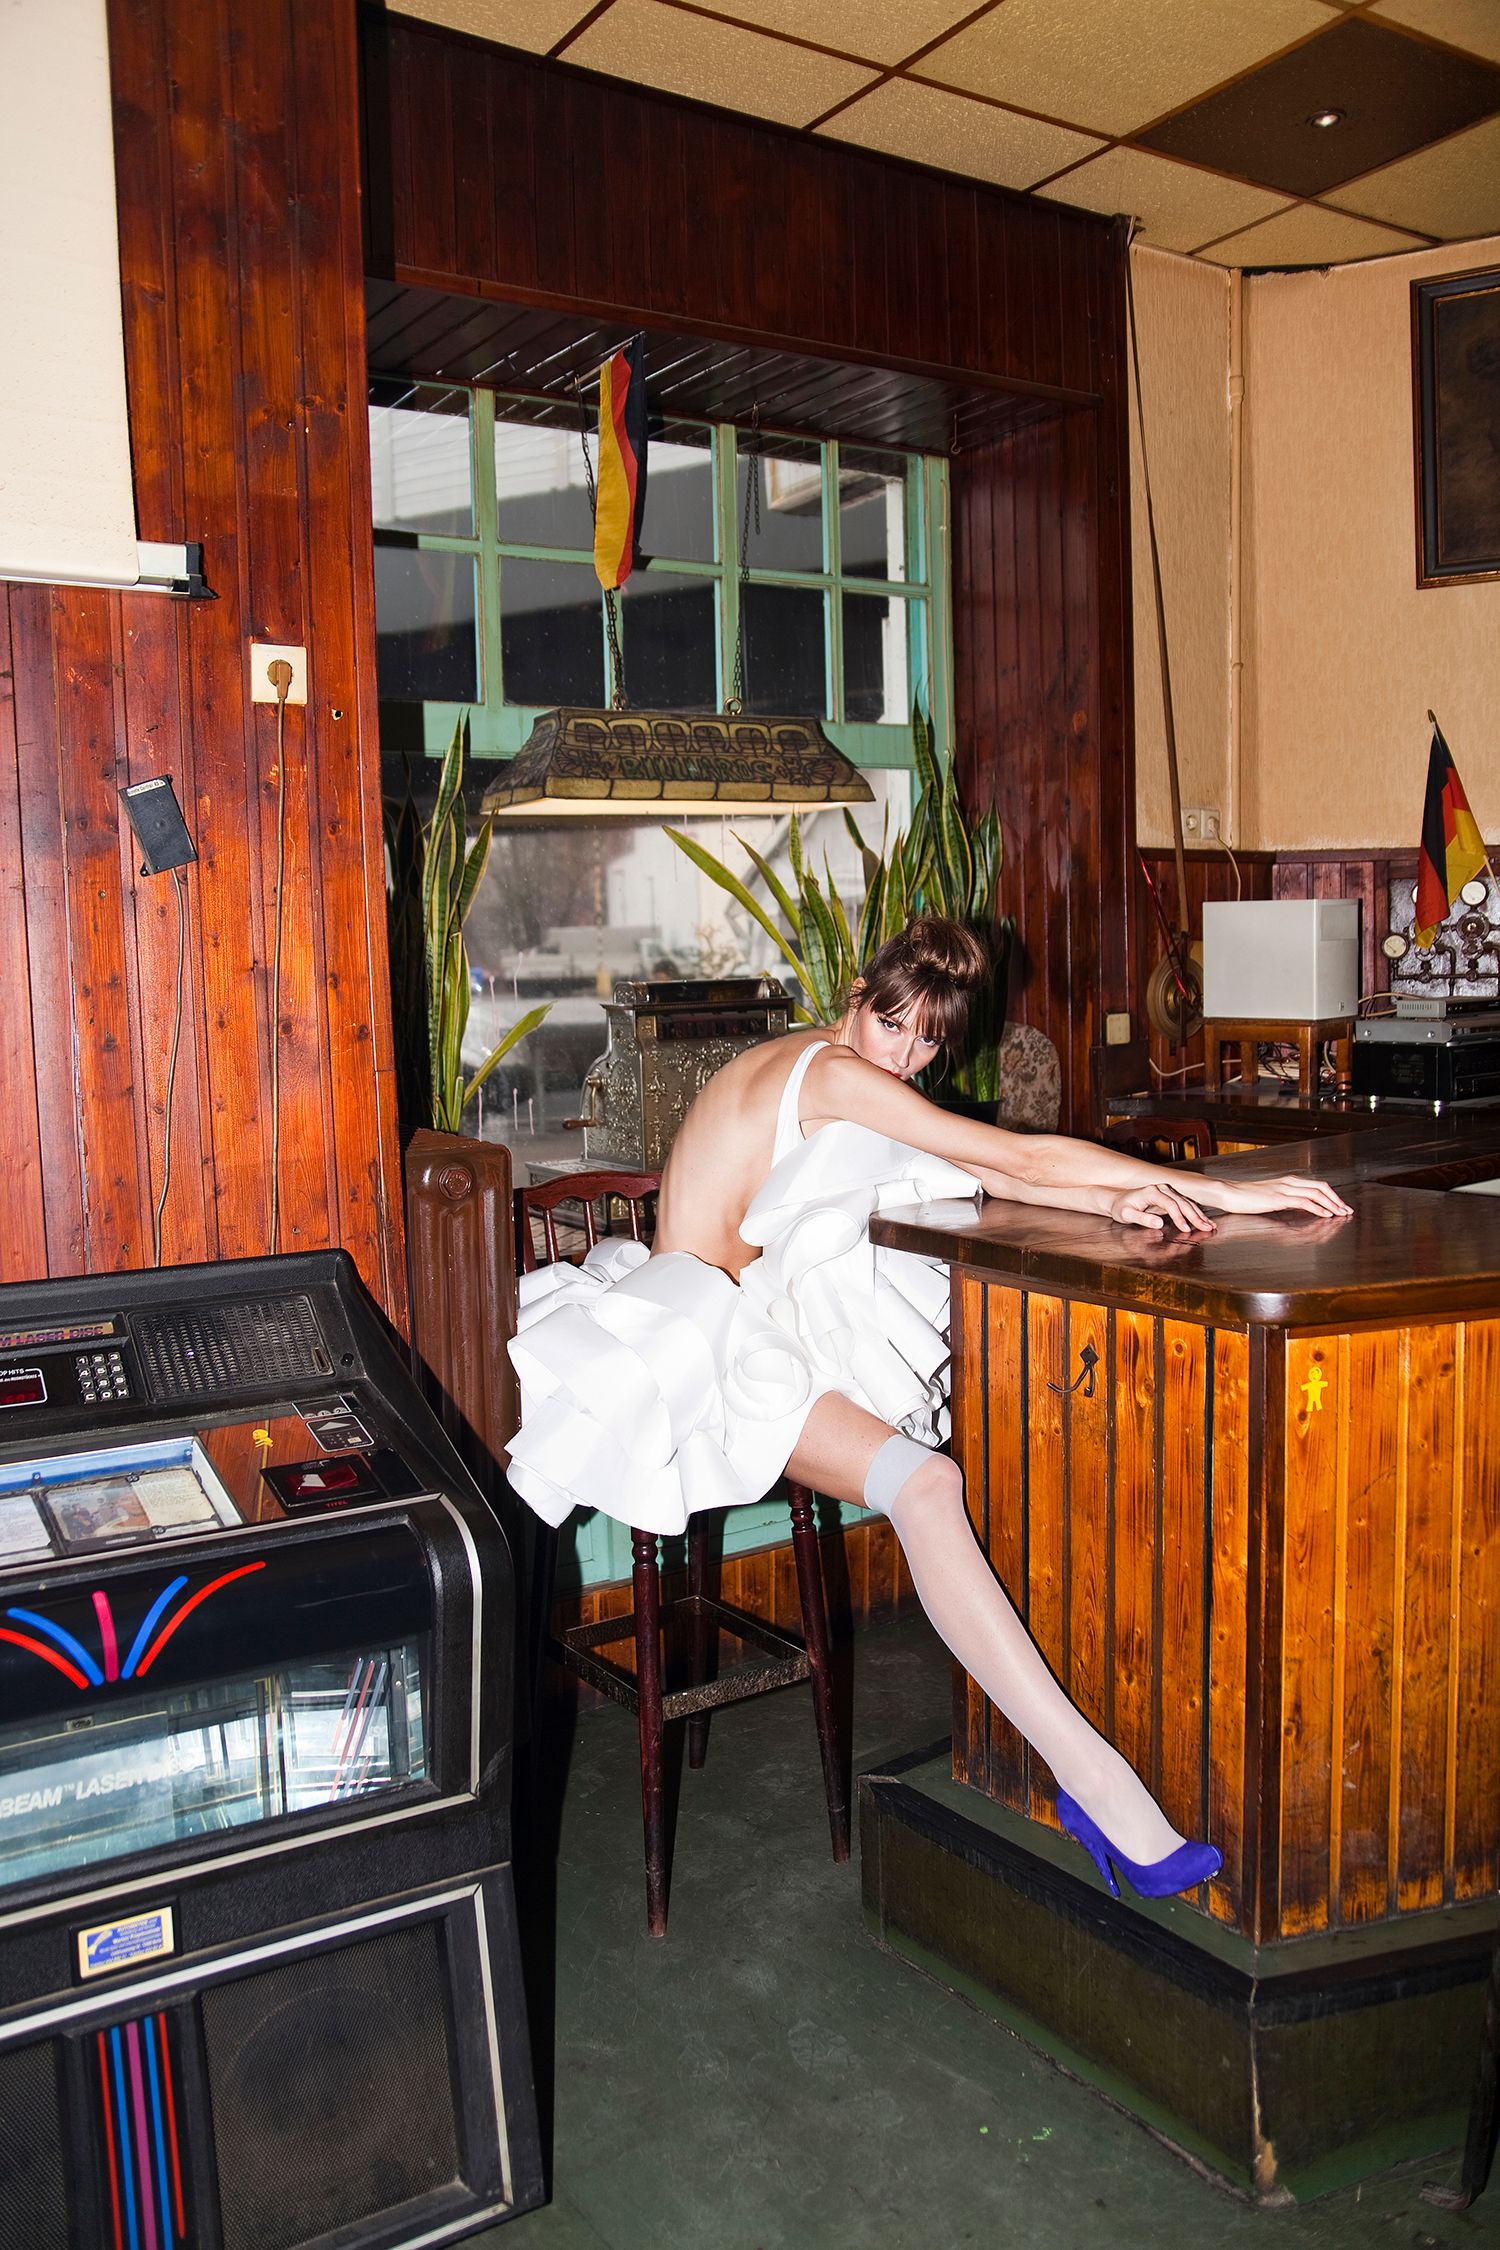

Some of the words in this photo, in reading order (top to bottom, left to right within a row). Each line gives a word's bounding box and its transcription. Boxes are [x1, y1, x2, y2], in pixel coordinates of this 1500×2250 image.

[619, 754, 776, 784] BILLIARDS
[15, 1330, 64, 1345] LASER
[69, 1325, 103, 1339] DISC
[8, 1368, 25, 1376] HITS
